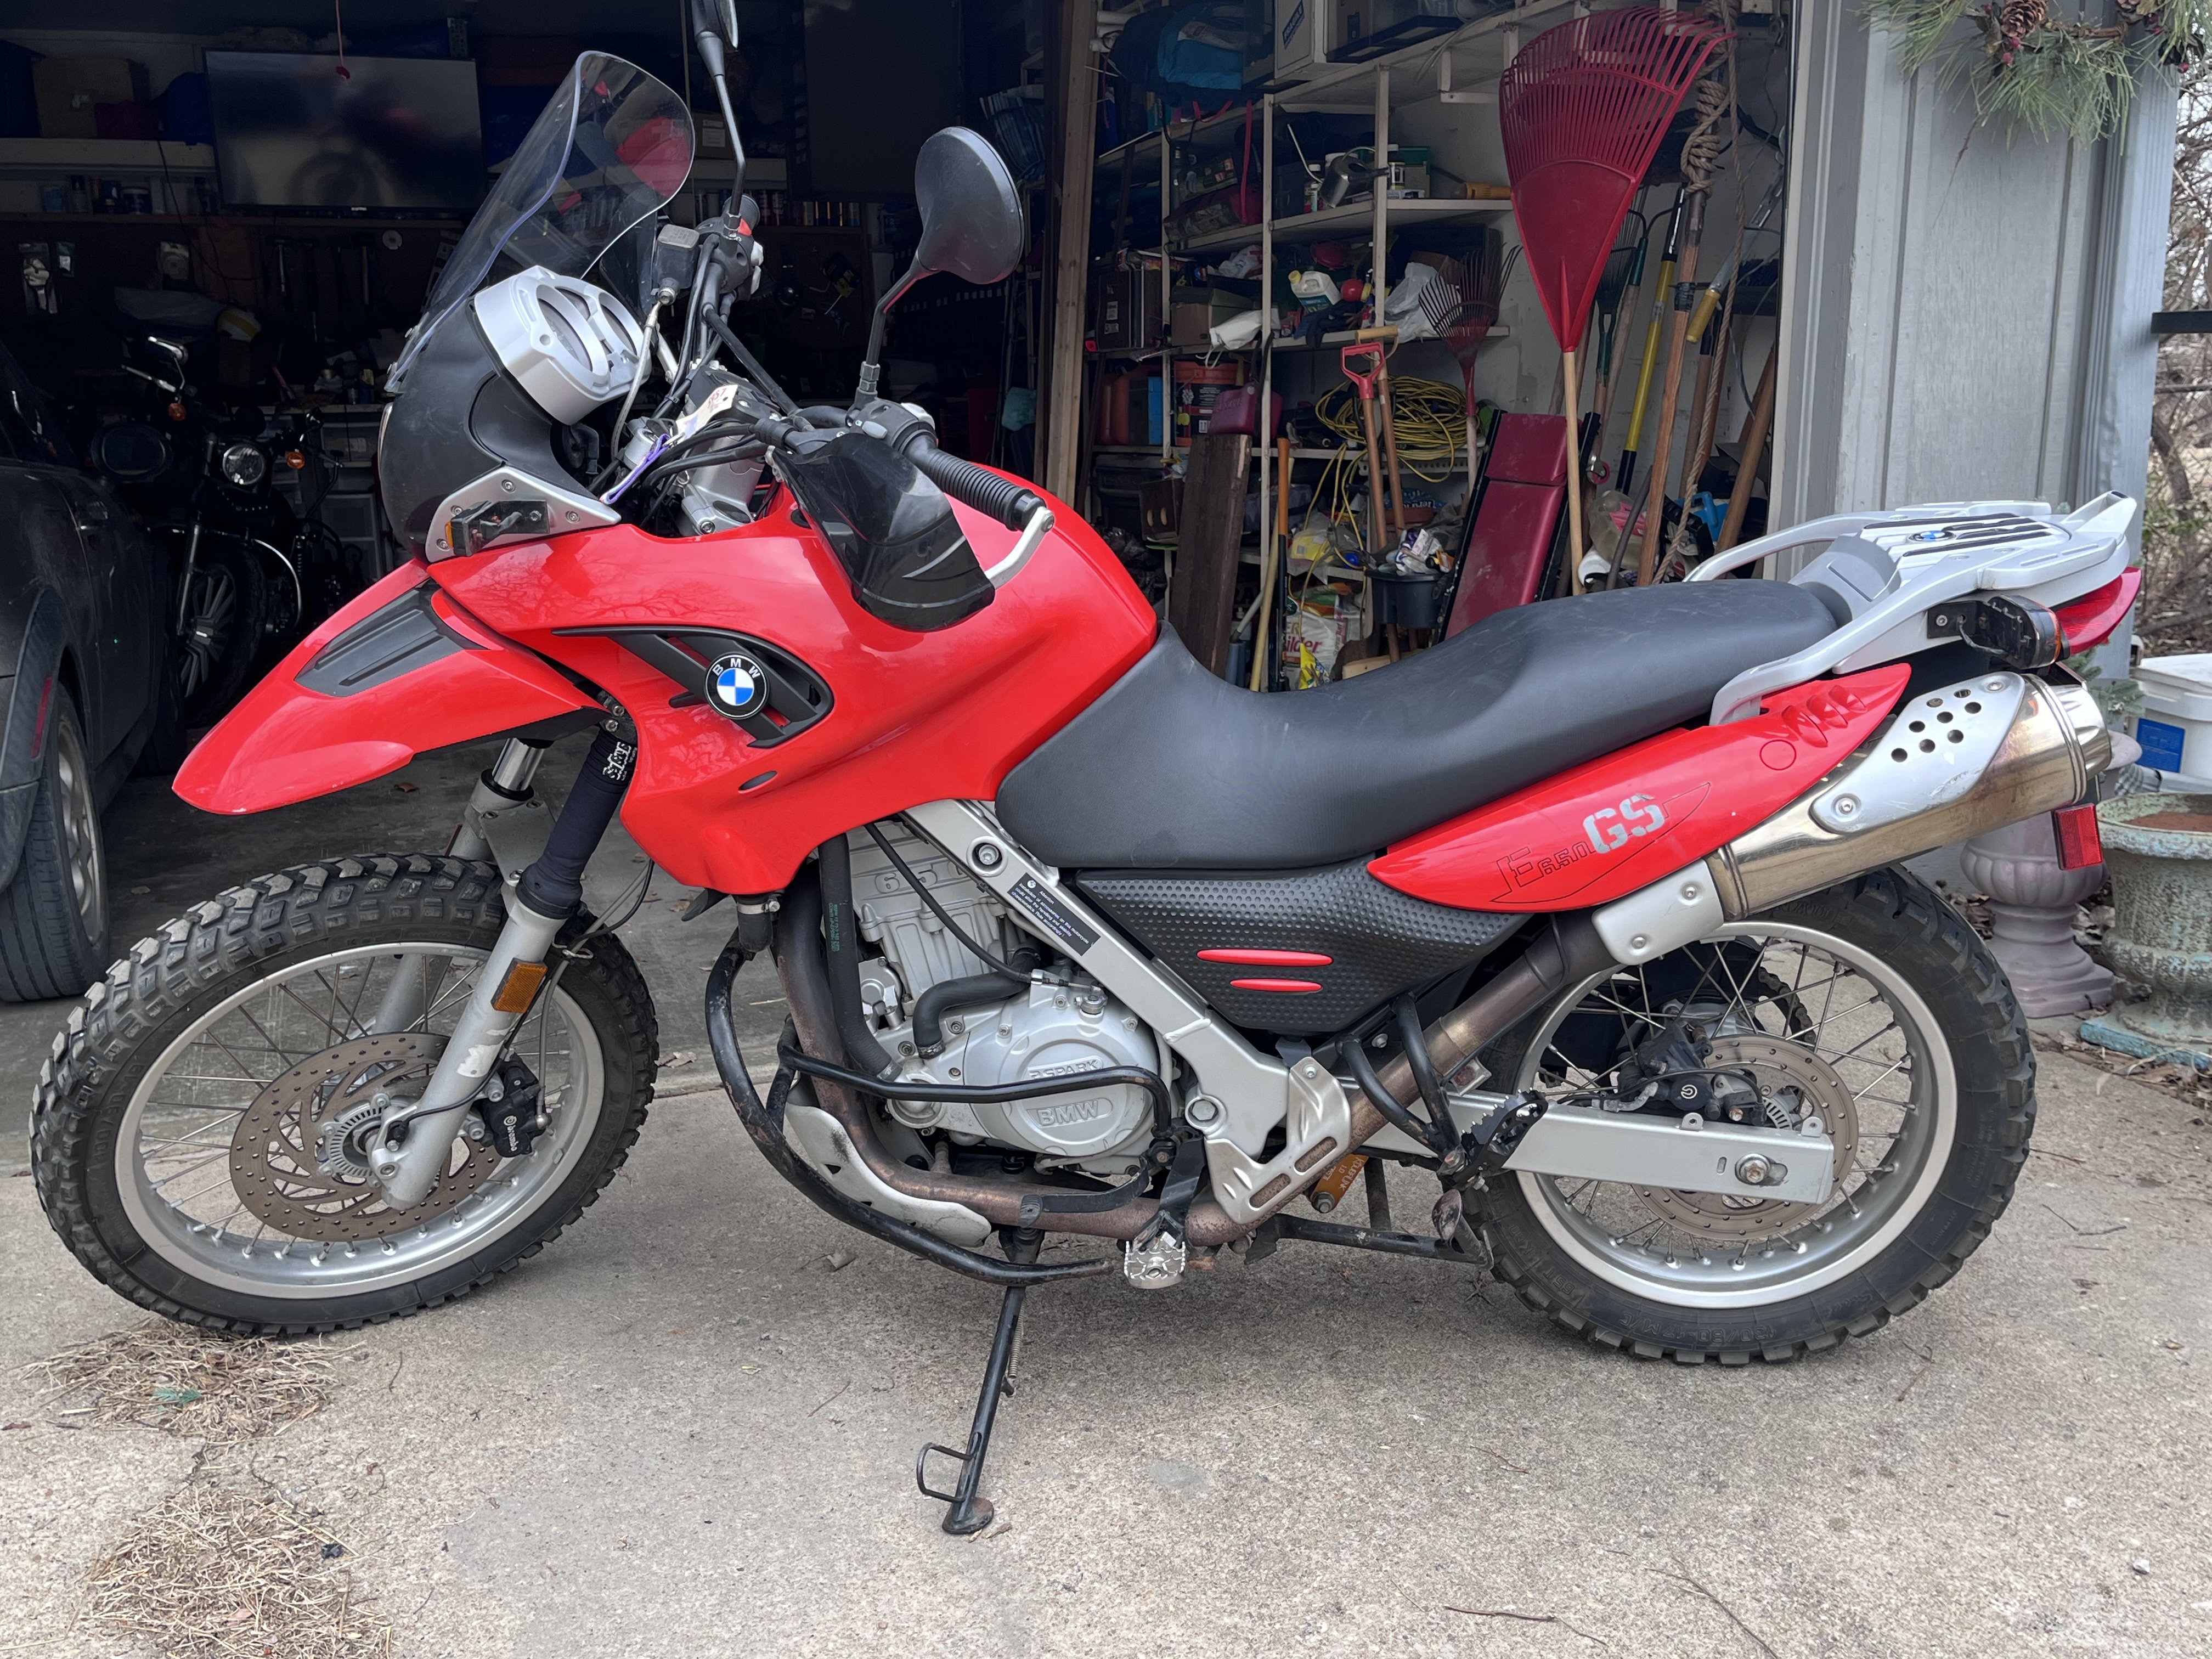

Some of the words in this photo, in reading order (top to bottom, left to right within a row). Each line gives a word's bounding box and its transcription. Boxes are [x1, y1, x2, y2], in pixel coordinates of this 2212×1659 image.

[1286, 636, 1323, 654] ilder
[712, 658, 760, 679] BMW
[1583, 794, 1664, 854] GS
[1070, 927, 1090, 945] motorcycle
[1037, 1100, 1098, 1126] BMW
[507, 1125, 519, 1152] brembo
